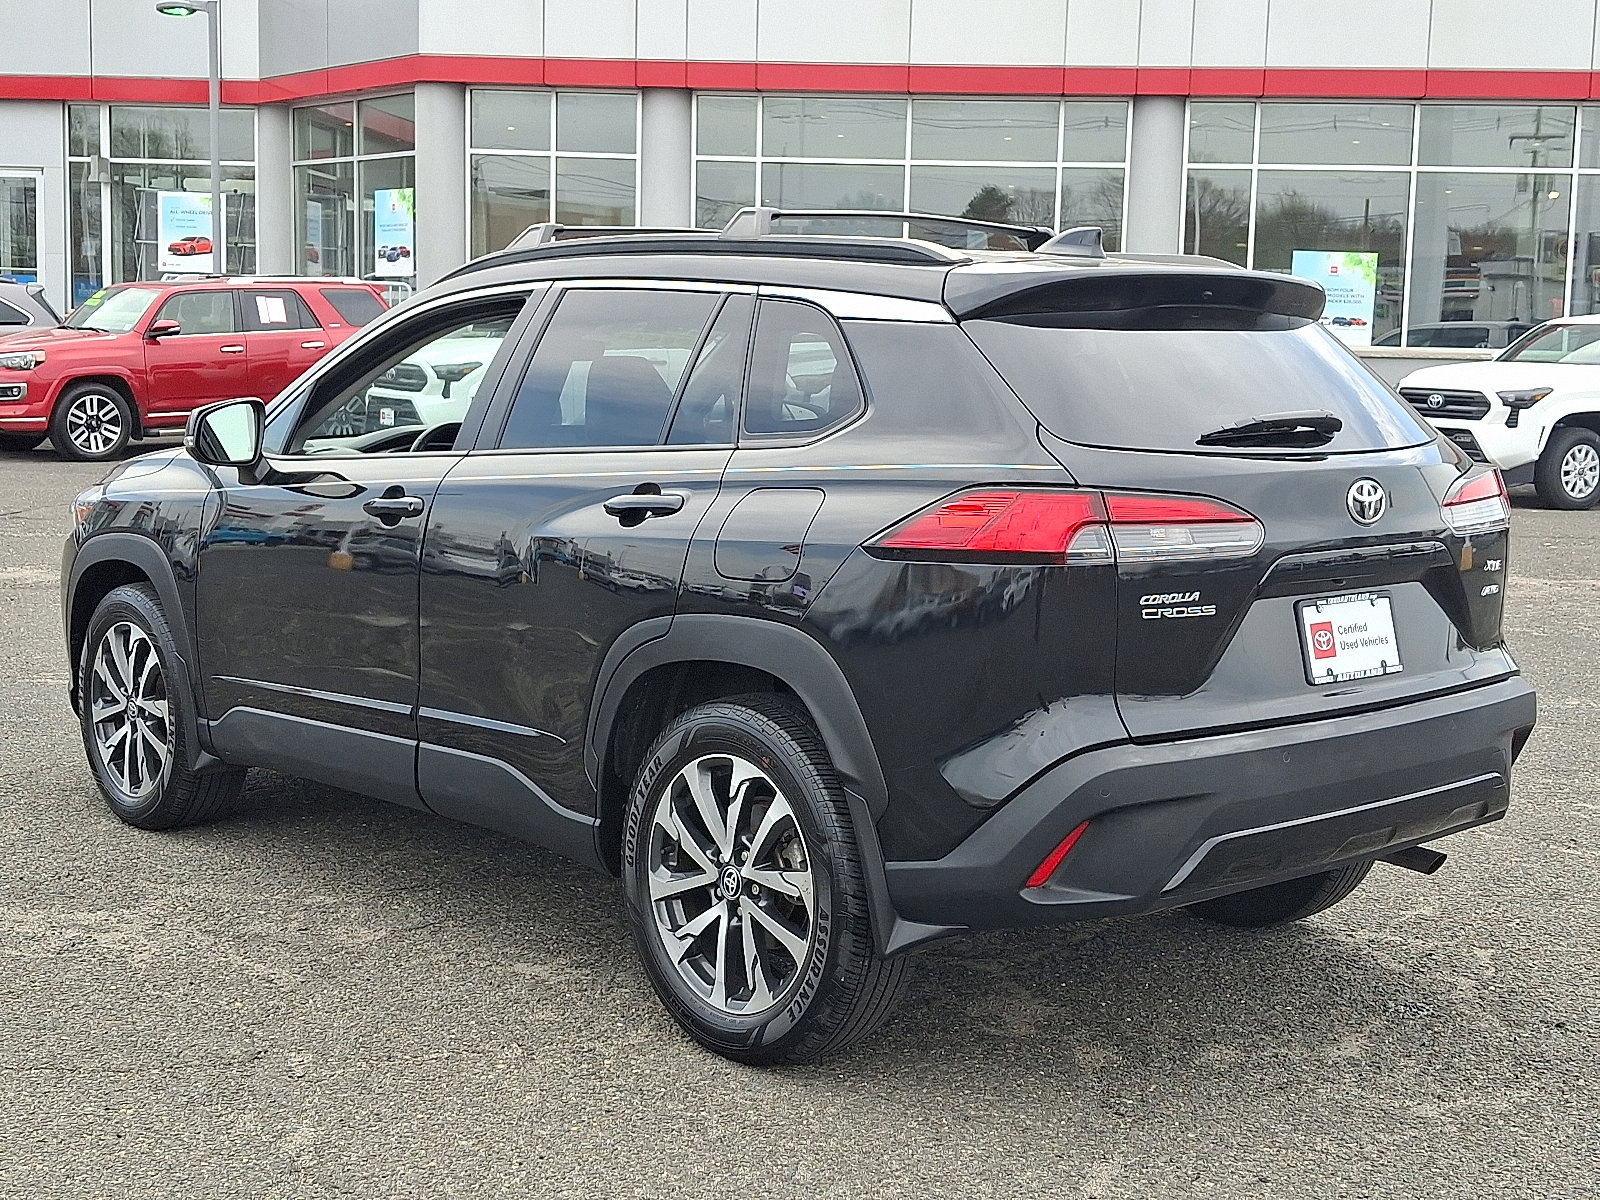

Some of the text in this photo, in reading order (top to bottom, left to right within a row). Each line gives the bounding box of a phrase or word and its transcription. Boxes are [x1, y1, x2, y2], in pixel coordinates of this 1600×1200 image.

[1139, 591, 1201, 606] COROLLA
[1141, 604, 1217, 620] CROSS
[1337, 622, 1368, 636] Certified
[1339, 636, 1389, 651] Used Vehicles
[625, 755, 663, 868] GOODYEAR
[786, 905, 830, 1024] ASSURANCE
